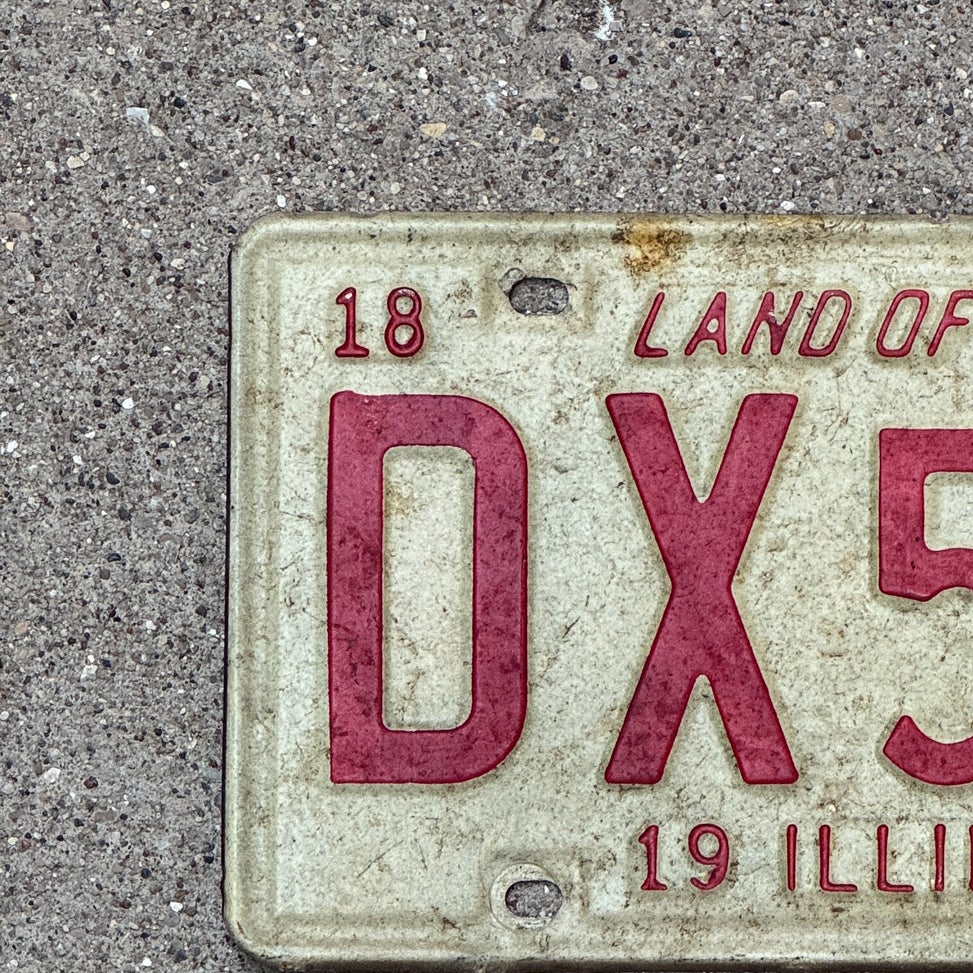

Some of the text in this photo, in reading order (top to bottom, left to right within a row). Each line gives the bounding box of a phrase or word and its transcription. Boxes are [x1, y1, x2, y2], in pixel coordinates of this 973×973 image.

[335, 286, 426, 358] 18
[634, 289, 853, 359] LAND
[639, 822, 731, 893] 19
